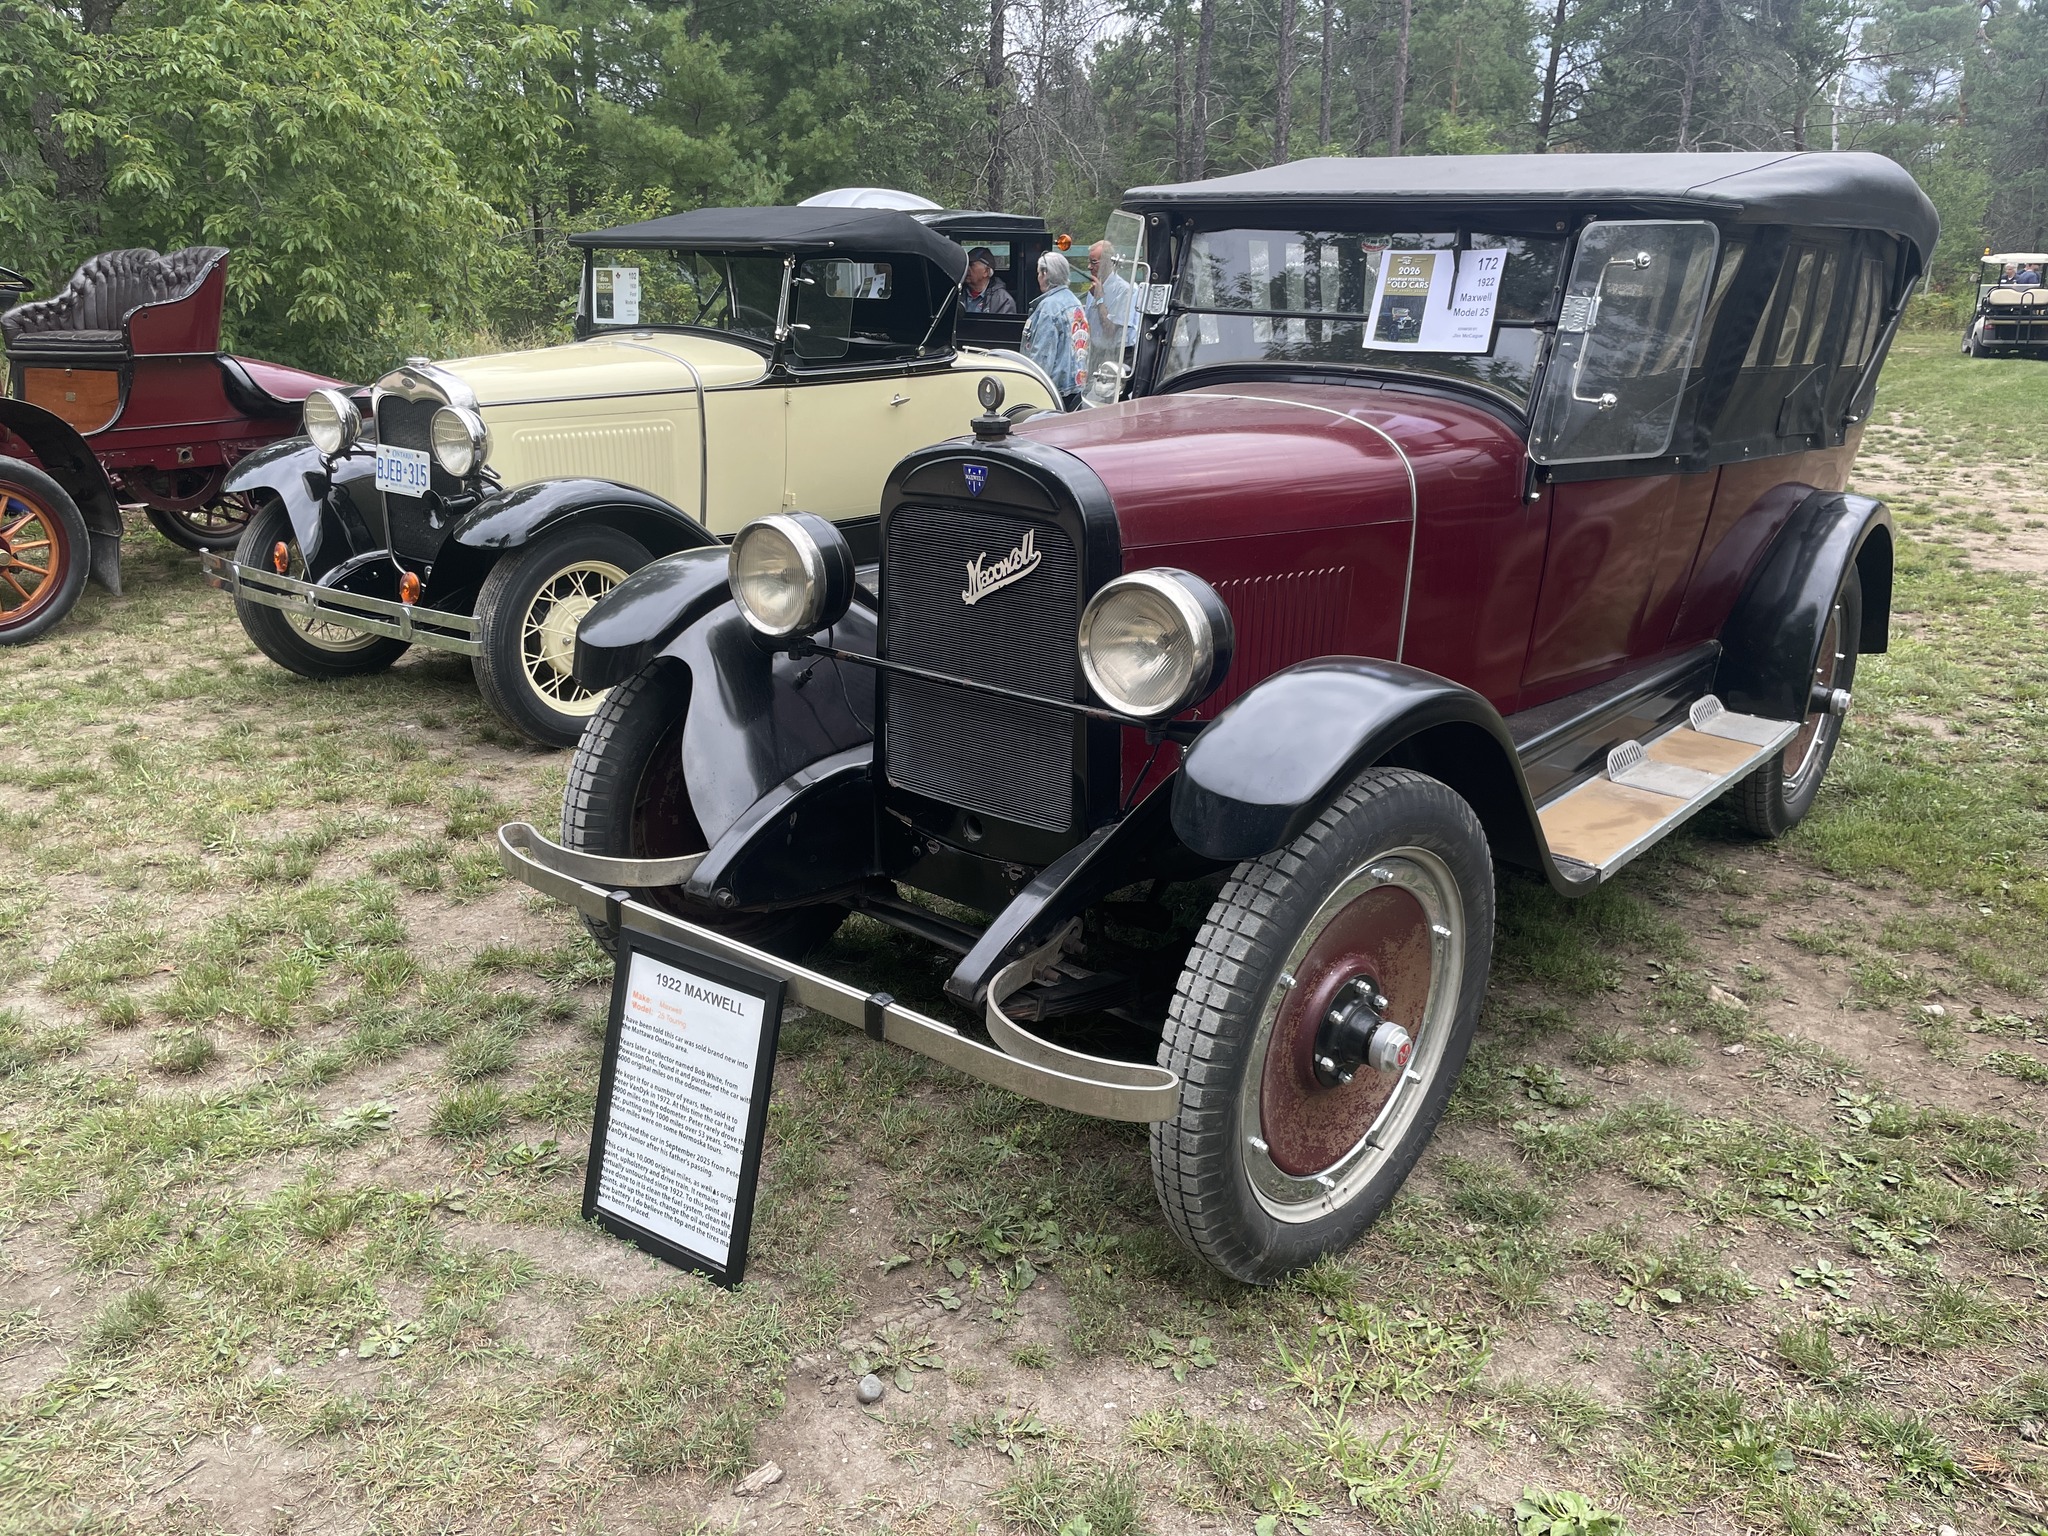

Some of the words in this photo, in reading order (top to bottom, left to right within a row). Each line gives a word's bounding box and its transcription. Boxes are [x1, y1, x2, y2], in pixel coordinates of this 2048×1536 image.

[1391, 281, 1408, 289] OLD
[1408, 281, 1429, 289] CARS
[1398, 266, 1421, 275] 2026
[1477, 277, 1495, 287] 1922
[1478, 257, 1499, 271] 172
[1453, 308, 1478, 317] Model
[1479, 308, 1490, 317] 25
[1460, 292, 1492, 302] Maxwell
[378, 457, 402, 482] BJEB
[408, 462, 427, 487] 315
[392, 450, 413, 460] ONTARIO
[962, 528, 1042, 605] Maxwell
[657, 973, 682, 992] 1922
[685, 983, 744, 1016] MAXWELL
[626, 1015, 638, 1025] have
[639, 1020, 652, 1030] been
[653, 1026, 664, 1036] told
[664, 1031, 674, 1039] this
[696, 1044, 707, 1052] sold
[707, 1047, 724, 1059] brand
[724, 1056, 736, 1064] new
[737, 1059, 748, 1069] into
[632, 1026, 654, 1040] Mattawa
[655, 1035, 675, 1048] Ontario
[675, 1044, 688, 1054] area.
[631, 1060, 652, 1072] original
[652, 1069, 666, 1078] miles
[675, 1077, 684, 1086] the
[684, 1082, 712, 1097] odometer.
[635, 1043, 647, 1053] later
[652, 1051, 674, 1064] collector
[675, 1061, 694, 1072] named
[694, 1067, 706, 1077] Bob
[707, 1072, 723, 1085] White,
[725, 1079, 738, 1090] from
[659, 1061, 675, 1073] found
[680, 1071, 691, 1080] and
[691, 1076, 720, 1091] purchased
[720, 1087, 729, 1096] the
[624, 1071, 636, 1081] kept
[641, 1078, 650, 1089] for
[654, 1085, 675, 1098] number
[683, 1097, 699, 1108] years,
[700, 1104, 713, 1114] then
[714, 1110, 726, 1119] sold
[630, 1082, 649, 1096] VanDyk
[657, 1094, 671, 1106] 1972.
[680, 1104, 690, 1113] this
[691, 1109, 703, 1119] time
[704, 1114, 714, 1123] the
[724, 1122, 735, 1132] had
[622, 1099, 642, 1112] putting
[643, 1108, 655, 1118] only
[656, 1112, 669, 1122] 1000
[670, 1119, 684, 1129] miles
[685, 1126, 698, 1134] over
[706, 1135, 722, 1146] years.
[723, 1141, 739, 1153] Some
[626, 1109, 640, 1119] miles
[641, 1116, 654, 1125] were
[663, 1125, 678, 1135] some
[707, 1143, 723, 1155] tours.
[627, 1092, 641, 1102] miles
[650, 1100, 659, 1109] the
[660, 1106, 687, 1121] odometer.
[688, 1116, 704, 1128] Peter
[704, 1125, 720, 1136] rarely
[721, 1131, 737, 1143] drove
[611, 1118, 640, 1134] purchased
[640, 1130, 649, 1138] the
[650, 1135, 658, 1143] car
[666, 1141, 696, 1158] September
[697, 1154, 710, 1166] 2025
[711, 1161, 725, 1172] from
[629, 1134, 646, 1146] Junior
[646, 1142, 660, 1152] after
[660, 1147, 668, 1156] his
[669, 1151, 690, 1166] father's
[690, 1162, 713, 1177] passing.
[620, 1157, 649, 1174] upholstery
[649, 1169, 660, 1178] and
[661, 1174, 675, 1185] drive
[676, 1181, 690, 1192] train.
[696, 1191, 719, 1205] remains
[626, 1148, 635, 1158] has
[655, 1163, 676, 1176] original
[677, 1173, 692, 1185] miles,
[701, 1184, 712, 1192] well
[612, 1196, 625, 1207] been
[615, 1172, 629, 1182] done
[646, 1186, 661, 1197] clean
[662, 1192, 671, 1202] the
[672, 1197, 683, 1207] fuel
[683, 1204, 704, 1218] system,
[705, 1213, 720, 1225] clean
[721, 1220, 731, 1230] the
[625, 1168, 654, 1184] untouched
[655, 1181, 668, 1191] since
[670, 1186, 684, 1198] 1922.
[693, 1198, 704, 1208] this
[704, 1204, 720, 1215] point
[720, 1211, 728, 1219] all
[636, 1189, 644, 1198] the
[660, 1201, 679, 1215] change
[680, 1210, 690, 1219] the
[698, 1220, 710, 1229] and
[710, 1224, 728, 1237] install
[644, 1202, 663, 1216] believe
[664, 1212, 673, 1221] the
[674, 1217, 684, 1227] top
[684, 1223, 696, 1232] and
[696, 1227, 706, 1236] the
[707, 1232, 719, 1243] tires
